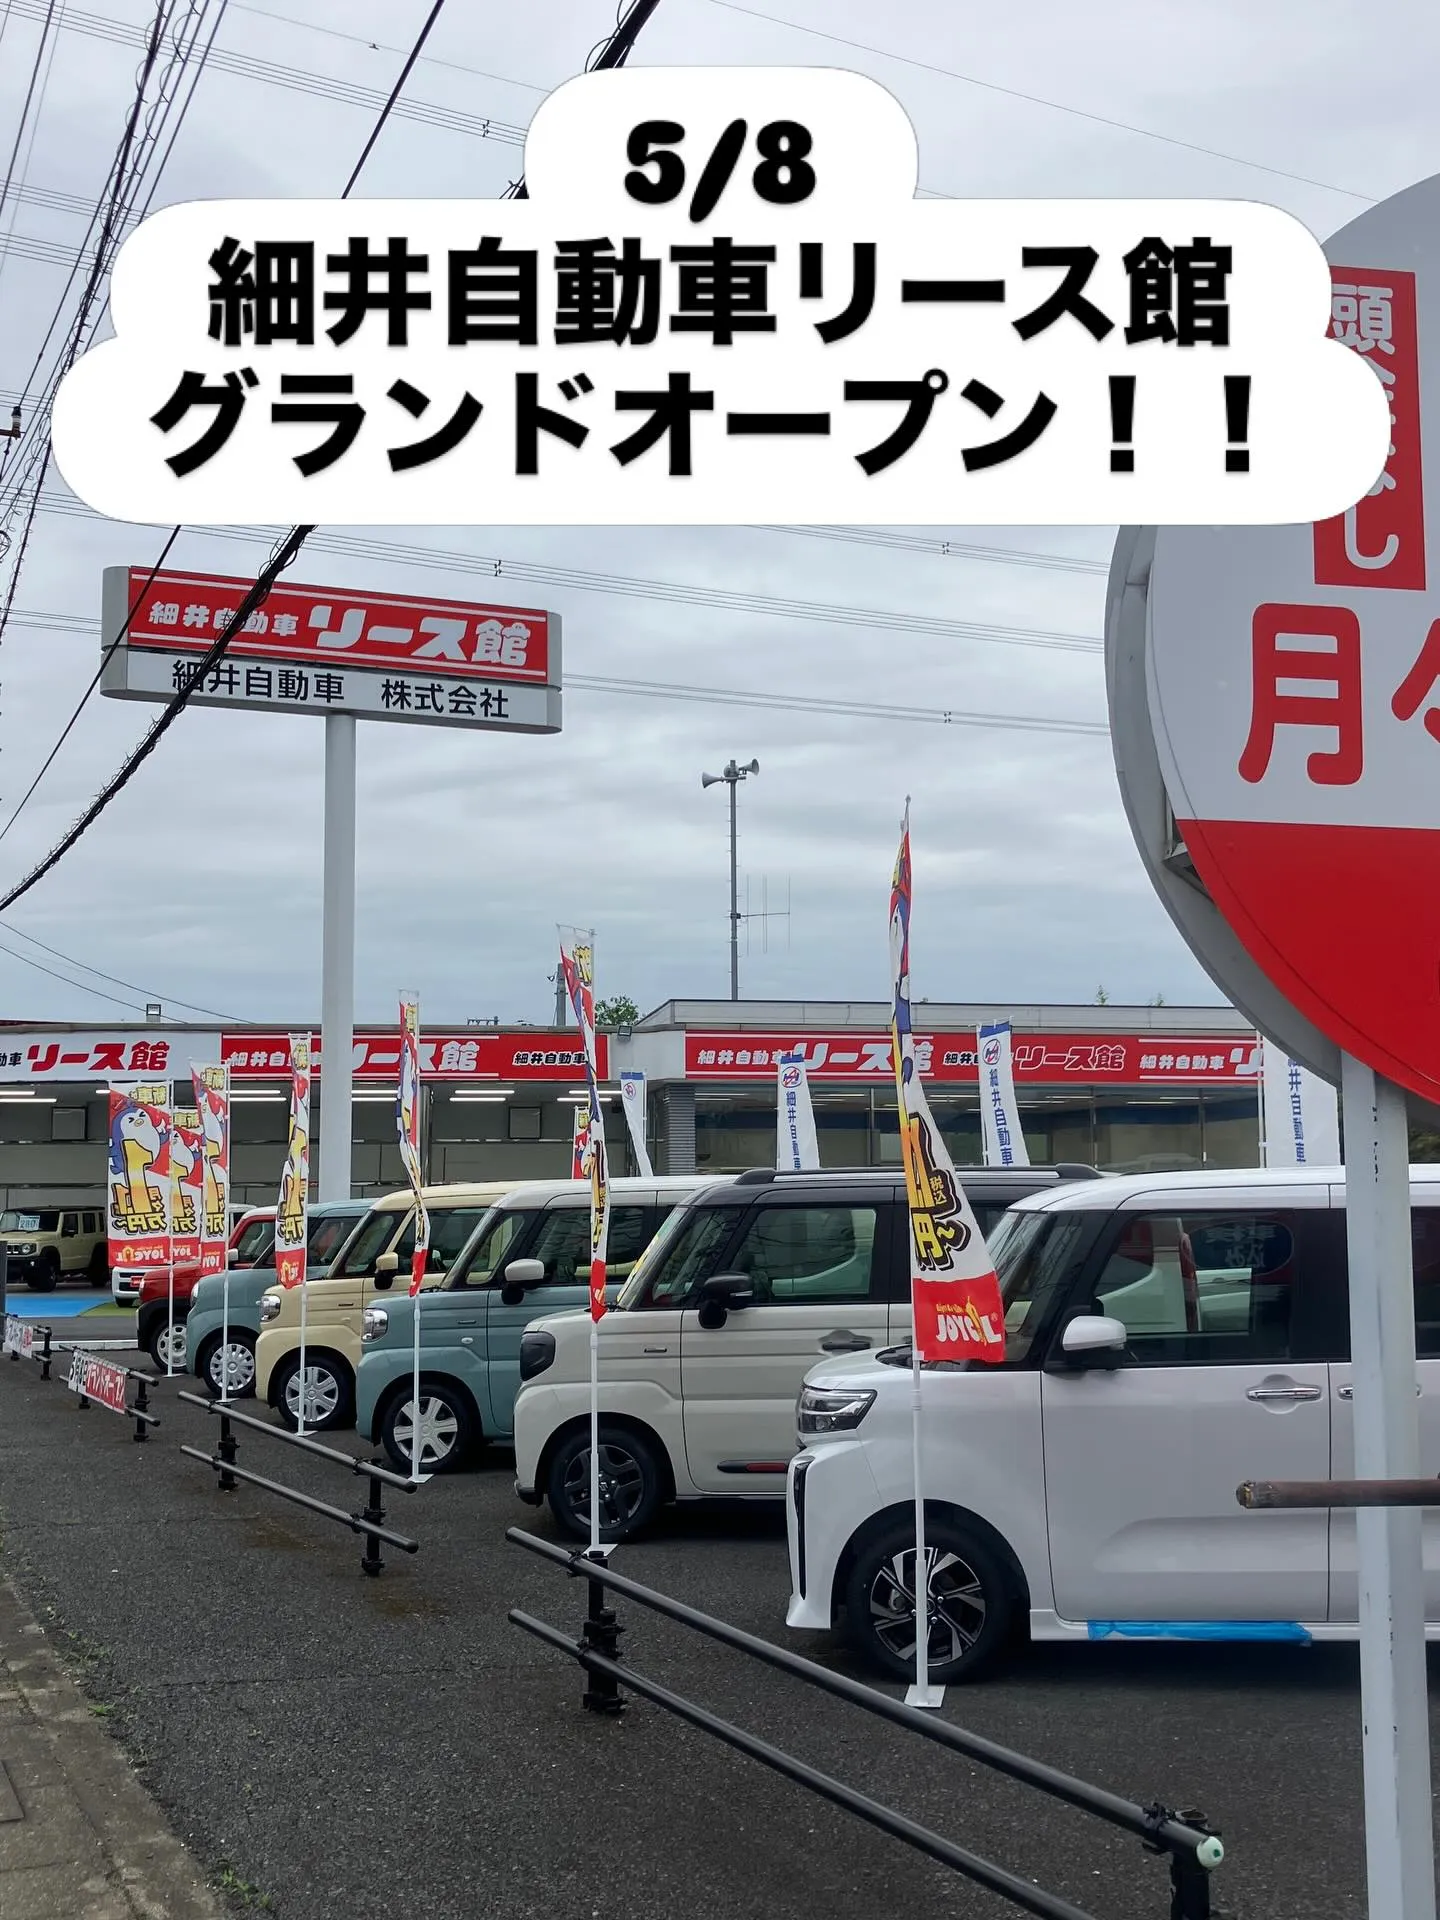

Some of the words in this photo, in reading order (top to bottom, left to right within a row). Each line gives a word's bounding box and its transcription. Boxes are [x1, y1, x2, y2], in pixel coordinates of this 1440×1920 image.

[149, 601, 299, 636] 細井自動車
[308, 605, 531, 666] リース館
[172, 660, 344, 703] 細井自動車
[381, 678, 509, 719] 株式会社
[27, 1041, 170, 1072] リース館
[512, 1051, 589, 1065] 細井自動車
[1015, 1045, 1126, 1071] リース館
[1139, 1054, 1225, 1070] 細井自動車
[989, 1068, 1014, 1166] 細井自動車
[929, 1175, 947, 1205] 税込
